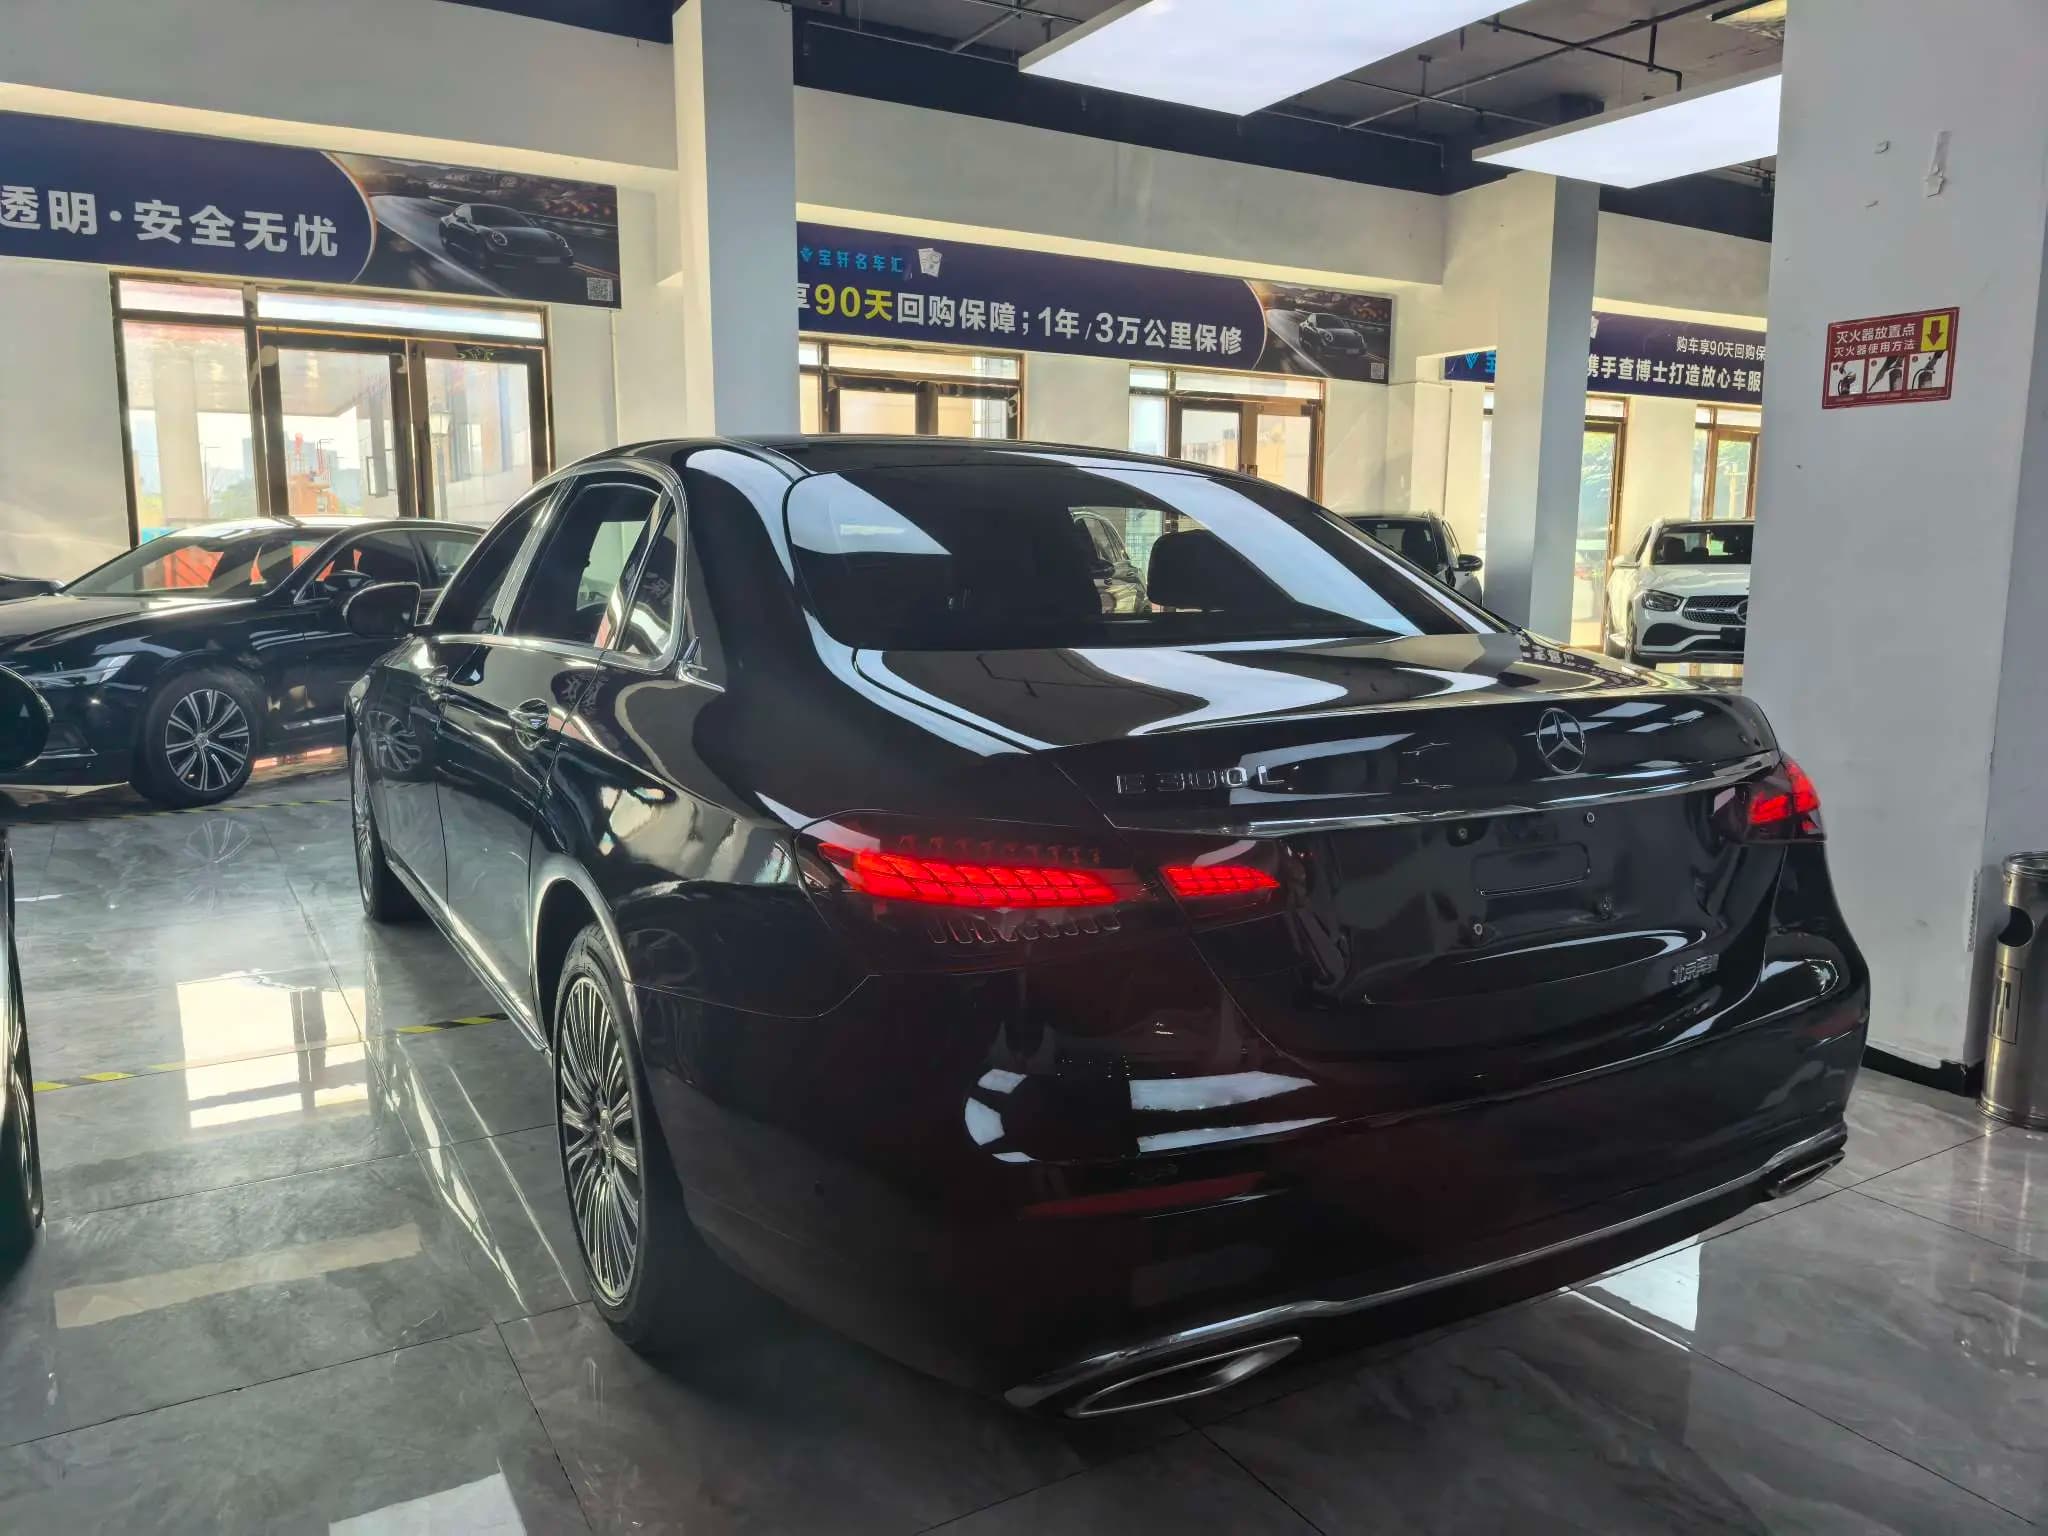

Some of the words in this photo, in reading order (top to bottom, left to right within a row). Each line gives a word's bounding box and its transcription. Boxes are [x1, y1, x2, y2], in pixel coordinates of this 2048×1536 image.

[0, 185, 338, 256] 透明·安全无忧
[818, 249, 903, 272] 宝轩名车汇
[1836, 322, 1916, 345] 灭火器放置点
[1834, 338, 1914, 358] 灭火器使用方法
